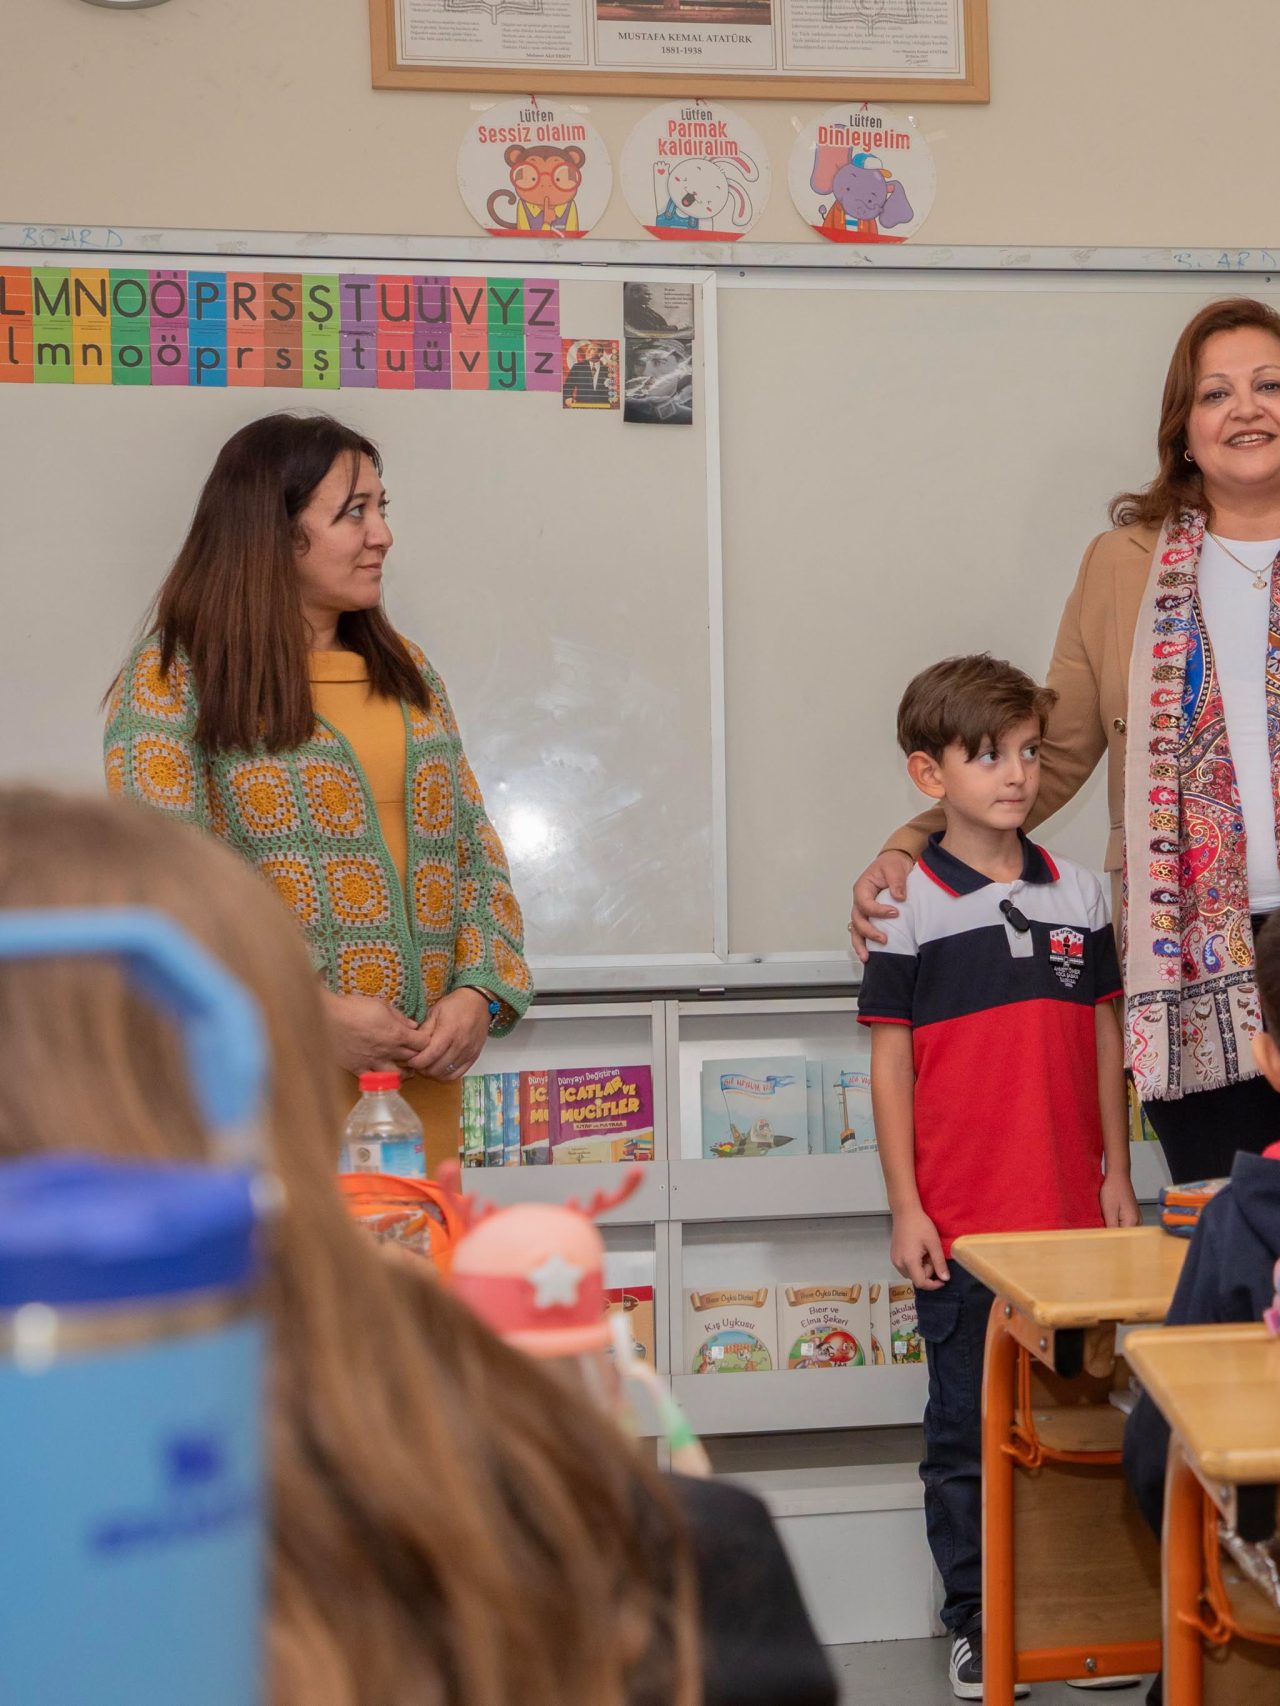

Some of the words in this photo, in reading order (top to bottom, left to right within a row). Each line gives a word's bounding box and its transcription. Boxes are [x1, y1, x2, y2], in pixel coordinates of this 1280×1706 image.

[618, 32, 666, 41] MUSTAFA
[668, 33, 702, 42] KEMAL
[703, 34, 752, 43] ATATÜRK
[661, 46, 702, 55] 1881-1938
[520, 110, 554, 123] Lütfen
[681, 109, 713, 121] Lütfen
[850, 114, 882, 128] Lütfen
[478, 124, 531, 143] Sessiz
[537, 124, 586, 142] olalım
[668, 121, 728, 138] Parmak
[658, 138, 738, 156] kaldıralım
[818, 126, 910, 152] Dinleyelim
[558, 1074, 585, 1086] Dünyayı
[586, 1068, 620, 1081] Değiştiren
[560, 1076, 623, 1104] İCATLAR
[561, 1098, 640, 1124] MUCİTLER
[704, 1322, 720, 1333] Kış
[722, 1317, 755, 1330] Uykusu
[800, 1317, 821, 1328] Elma
[823, 1314, 849, 1327] Şekeri
